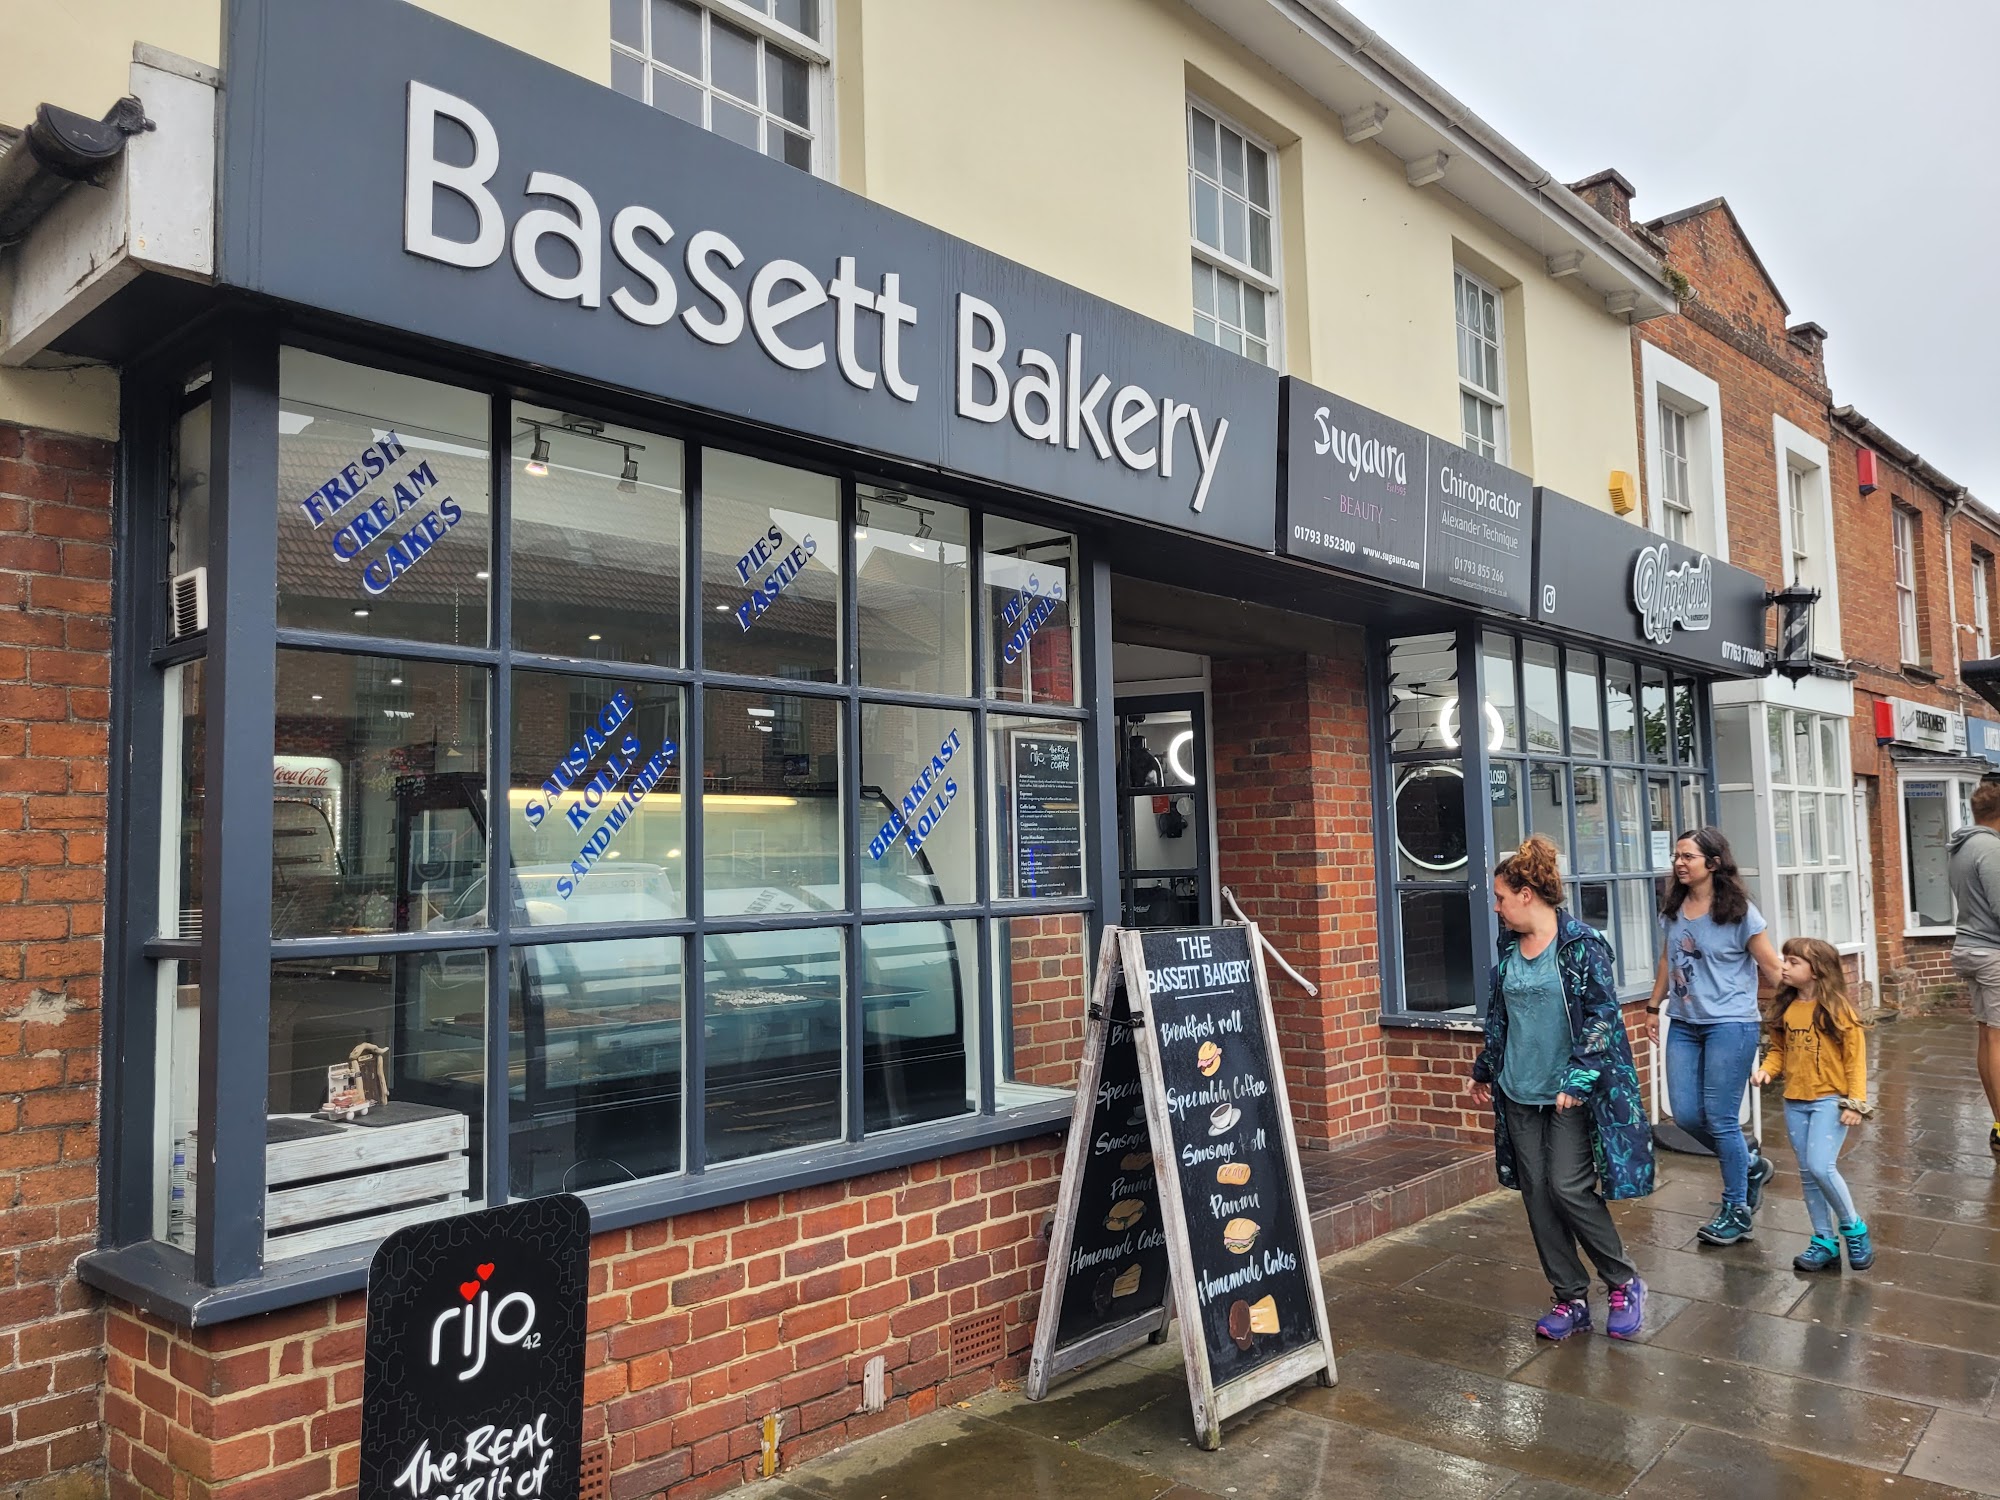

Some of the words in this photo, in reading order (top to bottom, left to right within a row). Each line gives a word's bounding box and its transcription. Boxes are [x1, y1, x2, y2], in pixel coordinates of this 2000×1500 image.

[404, 79, 919, 403] Bassett
[956, 292, 1229, 513] Bakery
[1314, 406, 1407, 485] Sugaura
[300, 429, 407, 530] FRESH
[1440, 466, 1521, 519] Chiropractor
[332, 459, 439, 562] CREAM
[1340, 494, 1383, 524] BEAUTY
[1441, 509, 1480, 536] Alexander
[1482, 523, 1518, 550] Technique
[363, 496, 462, 594] CAKES
[735, 525, 782, 586] PIES
[1294, 525, 1321, 544] 01793
[1324, 533, 1356, 554] 852300
[1362, 546, 1420, 571] www.sugaura.com
[735, 533, 817, 633] PASTIES
[1454, 556, 1475, 575] 01793
[1477, 564, 1490, 579] 855
[1491, 569, 1504, 583] 266
[1001, 573, 1039, 628] TEAS
[1004, 581, 1062, 664] COFFEES
[1722, 640, 1742, 662] 07763
[525, 688, 633, 832] SAUSAGE
[565, 732, 640, 836] ROLLS
[1488, 769, 1507, 784] LOSED
[556, 736, 677, 900] SANDWICHES
[867, 727, 960, 860] BREAKFAST
[905, 777, 957, 859] ROLLS
[1176, 935, 1213, 961] THE
[1146, 965, 1201, 994] BASSETT
[1201, 959, 1251, 988] BAKERY
[1160, 1012, 1215, 1047] Breakfast
[1218, 1009, 1244, 1035] roll
[1233, 1073, 1268, 1100] Coffee
[1094, 1130, 1148, 1156] Sausage
[1182, 1140, 1238, 1167] Sausage
[1070, 1232, 1135, 1276] Homemade
[1137, 1227, 1167, 1250] Cakes
[1198, 1254, 1263, 1306] Homemade
[1263, 1246, 1297, 1275] Cakes
[431, 1273, 536, 1381] rijo
[522, 1332, 541, 1350] 42
[461, 1413, 553, 1470] REAL
[516, 1448, 554, 1497] of
